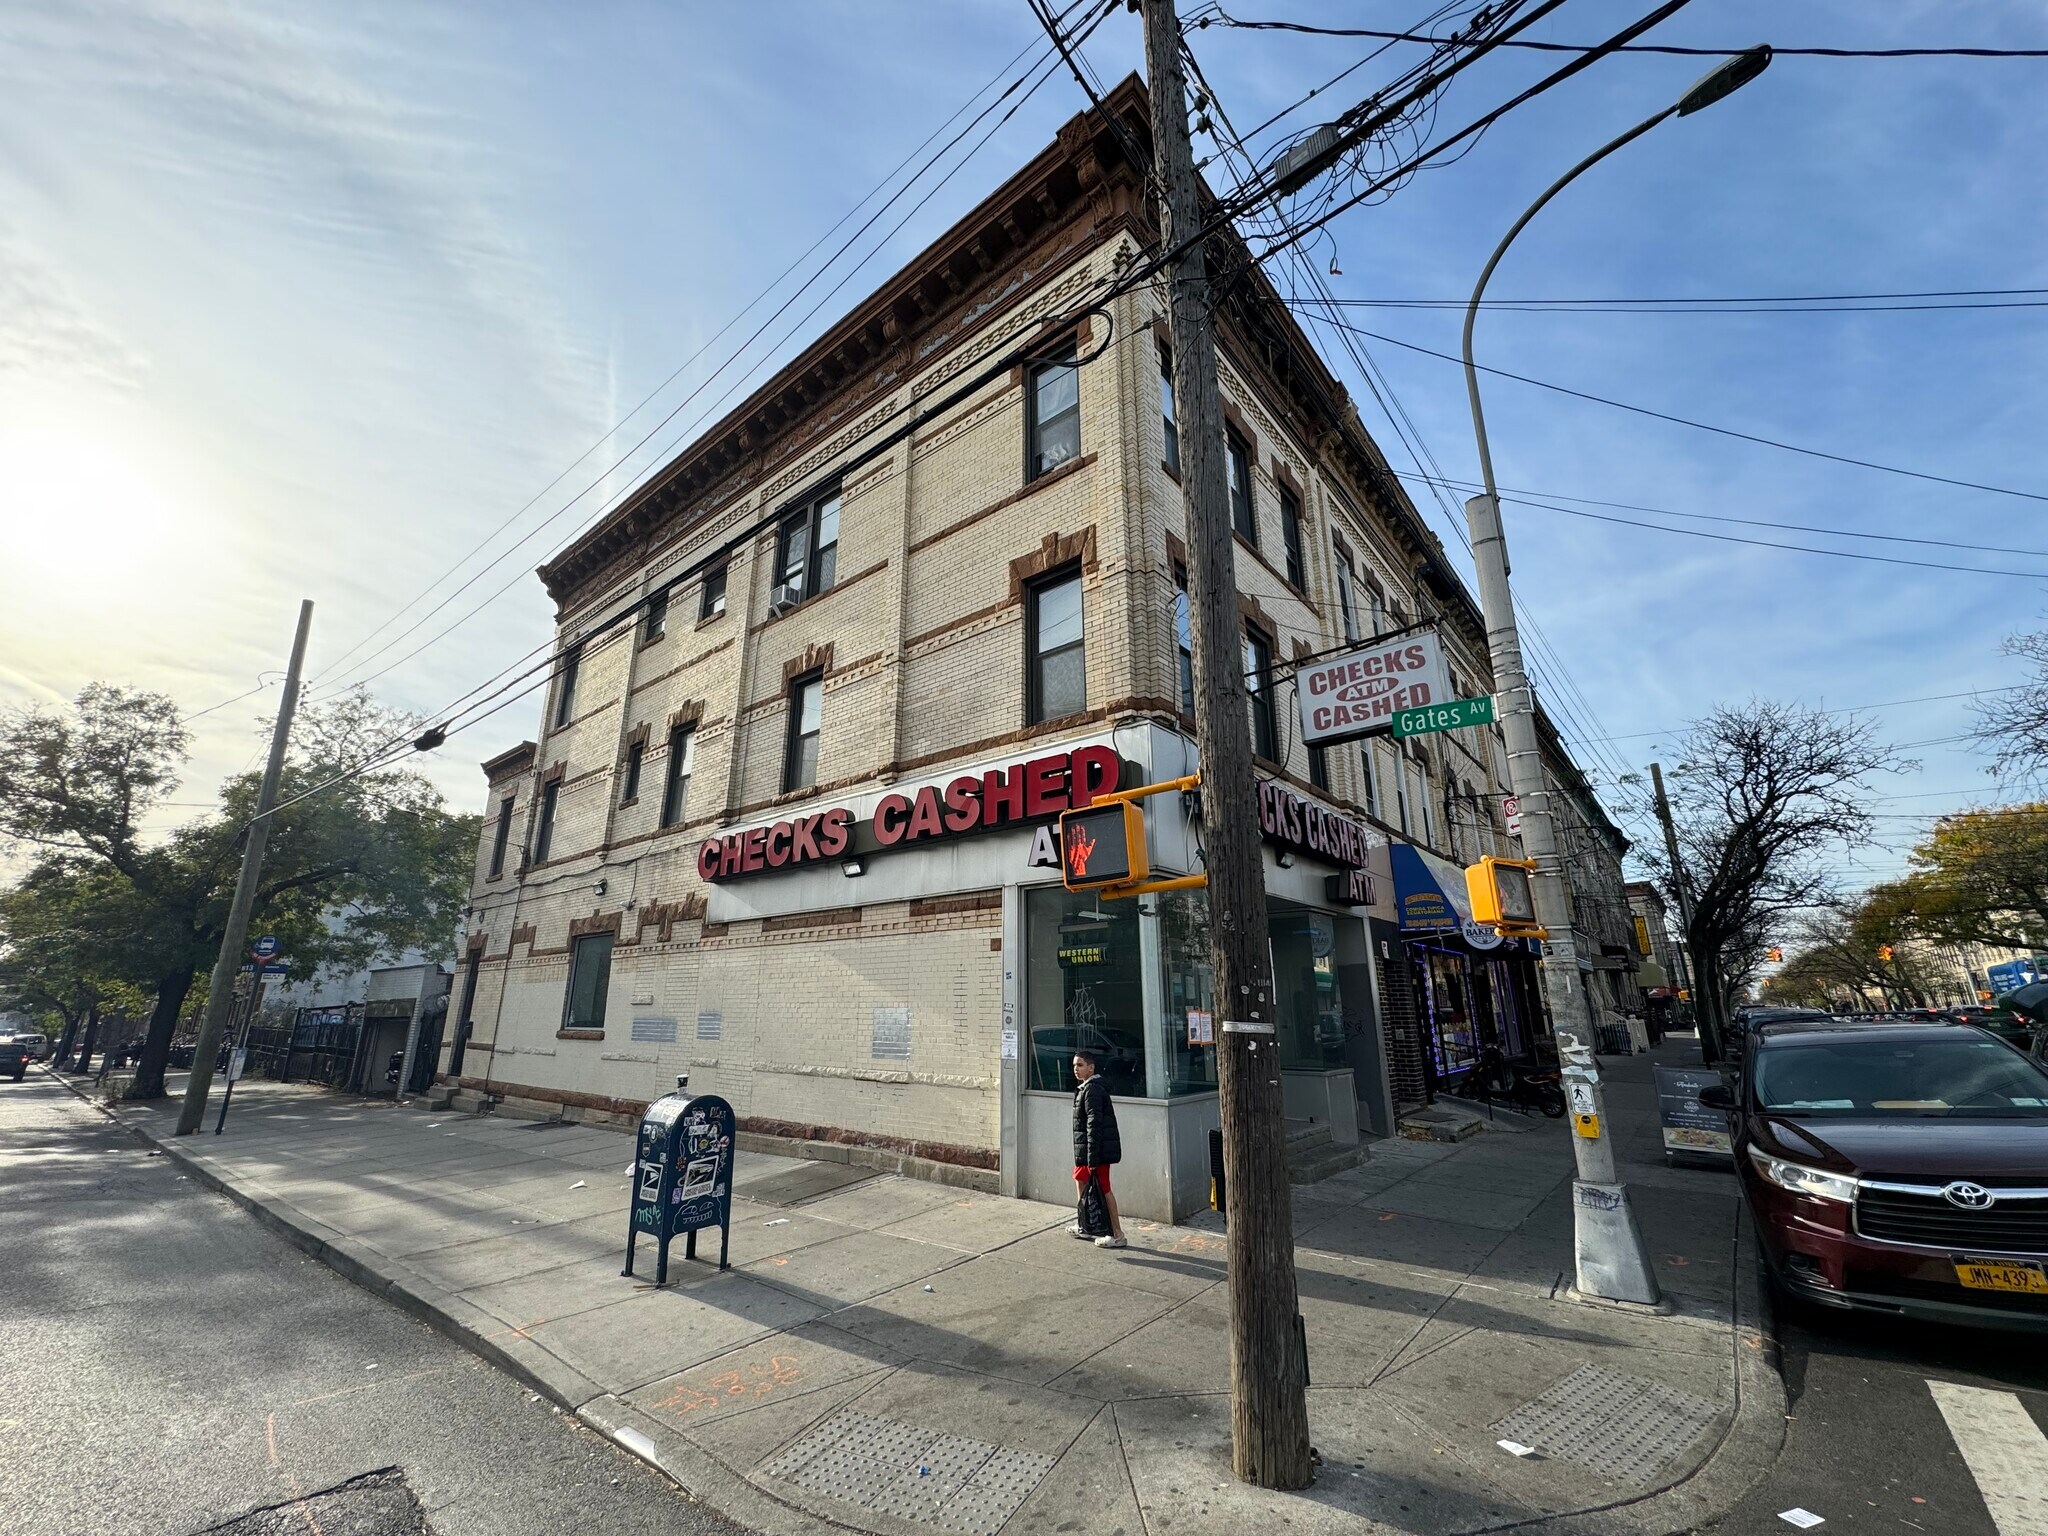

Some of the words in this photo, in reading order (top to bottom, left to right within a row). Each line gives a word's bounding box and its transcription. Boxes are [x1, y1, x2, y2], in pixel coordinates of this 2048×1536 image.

[1308, 644, 1427, 696] CHECKS
[1313, 682, 1431, 731] CASHED
[1345, 678, 1390, 701] ATM
[1401, 708, 1461, 733] Gates
[1470, 701, 1485, 715] Av
[697, 807, 852, 881] CHECKS
[873, 745, 1124, 846] CASHED
[1305, 801, 1369, 868] CASHED
[1349, 870, 1377, 905] ATM
[1059, 947, 1099, 957] WESTERN
[1071, 955, 1100, 963] UNION
